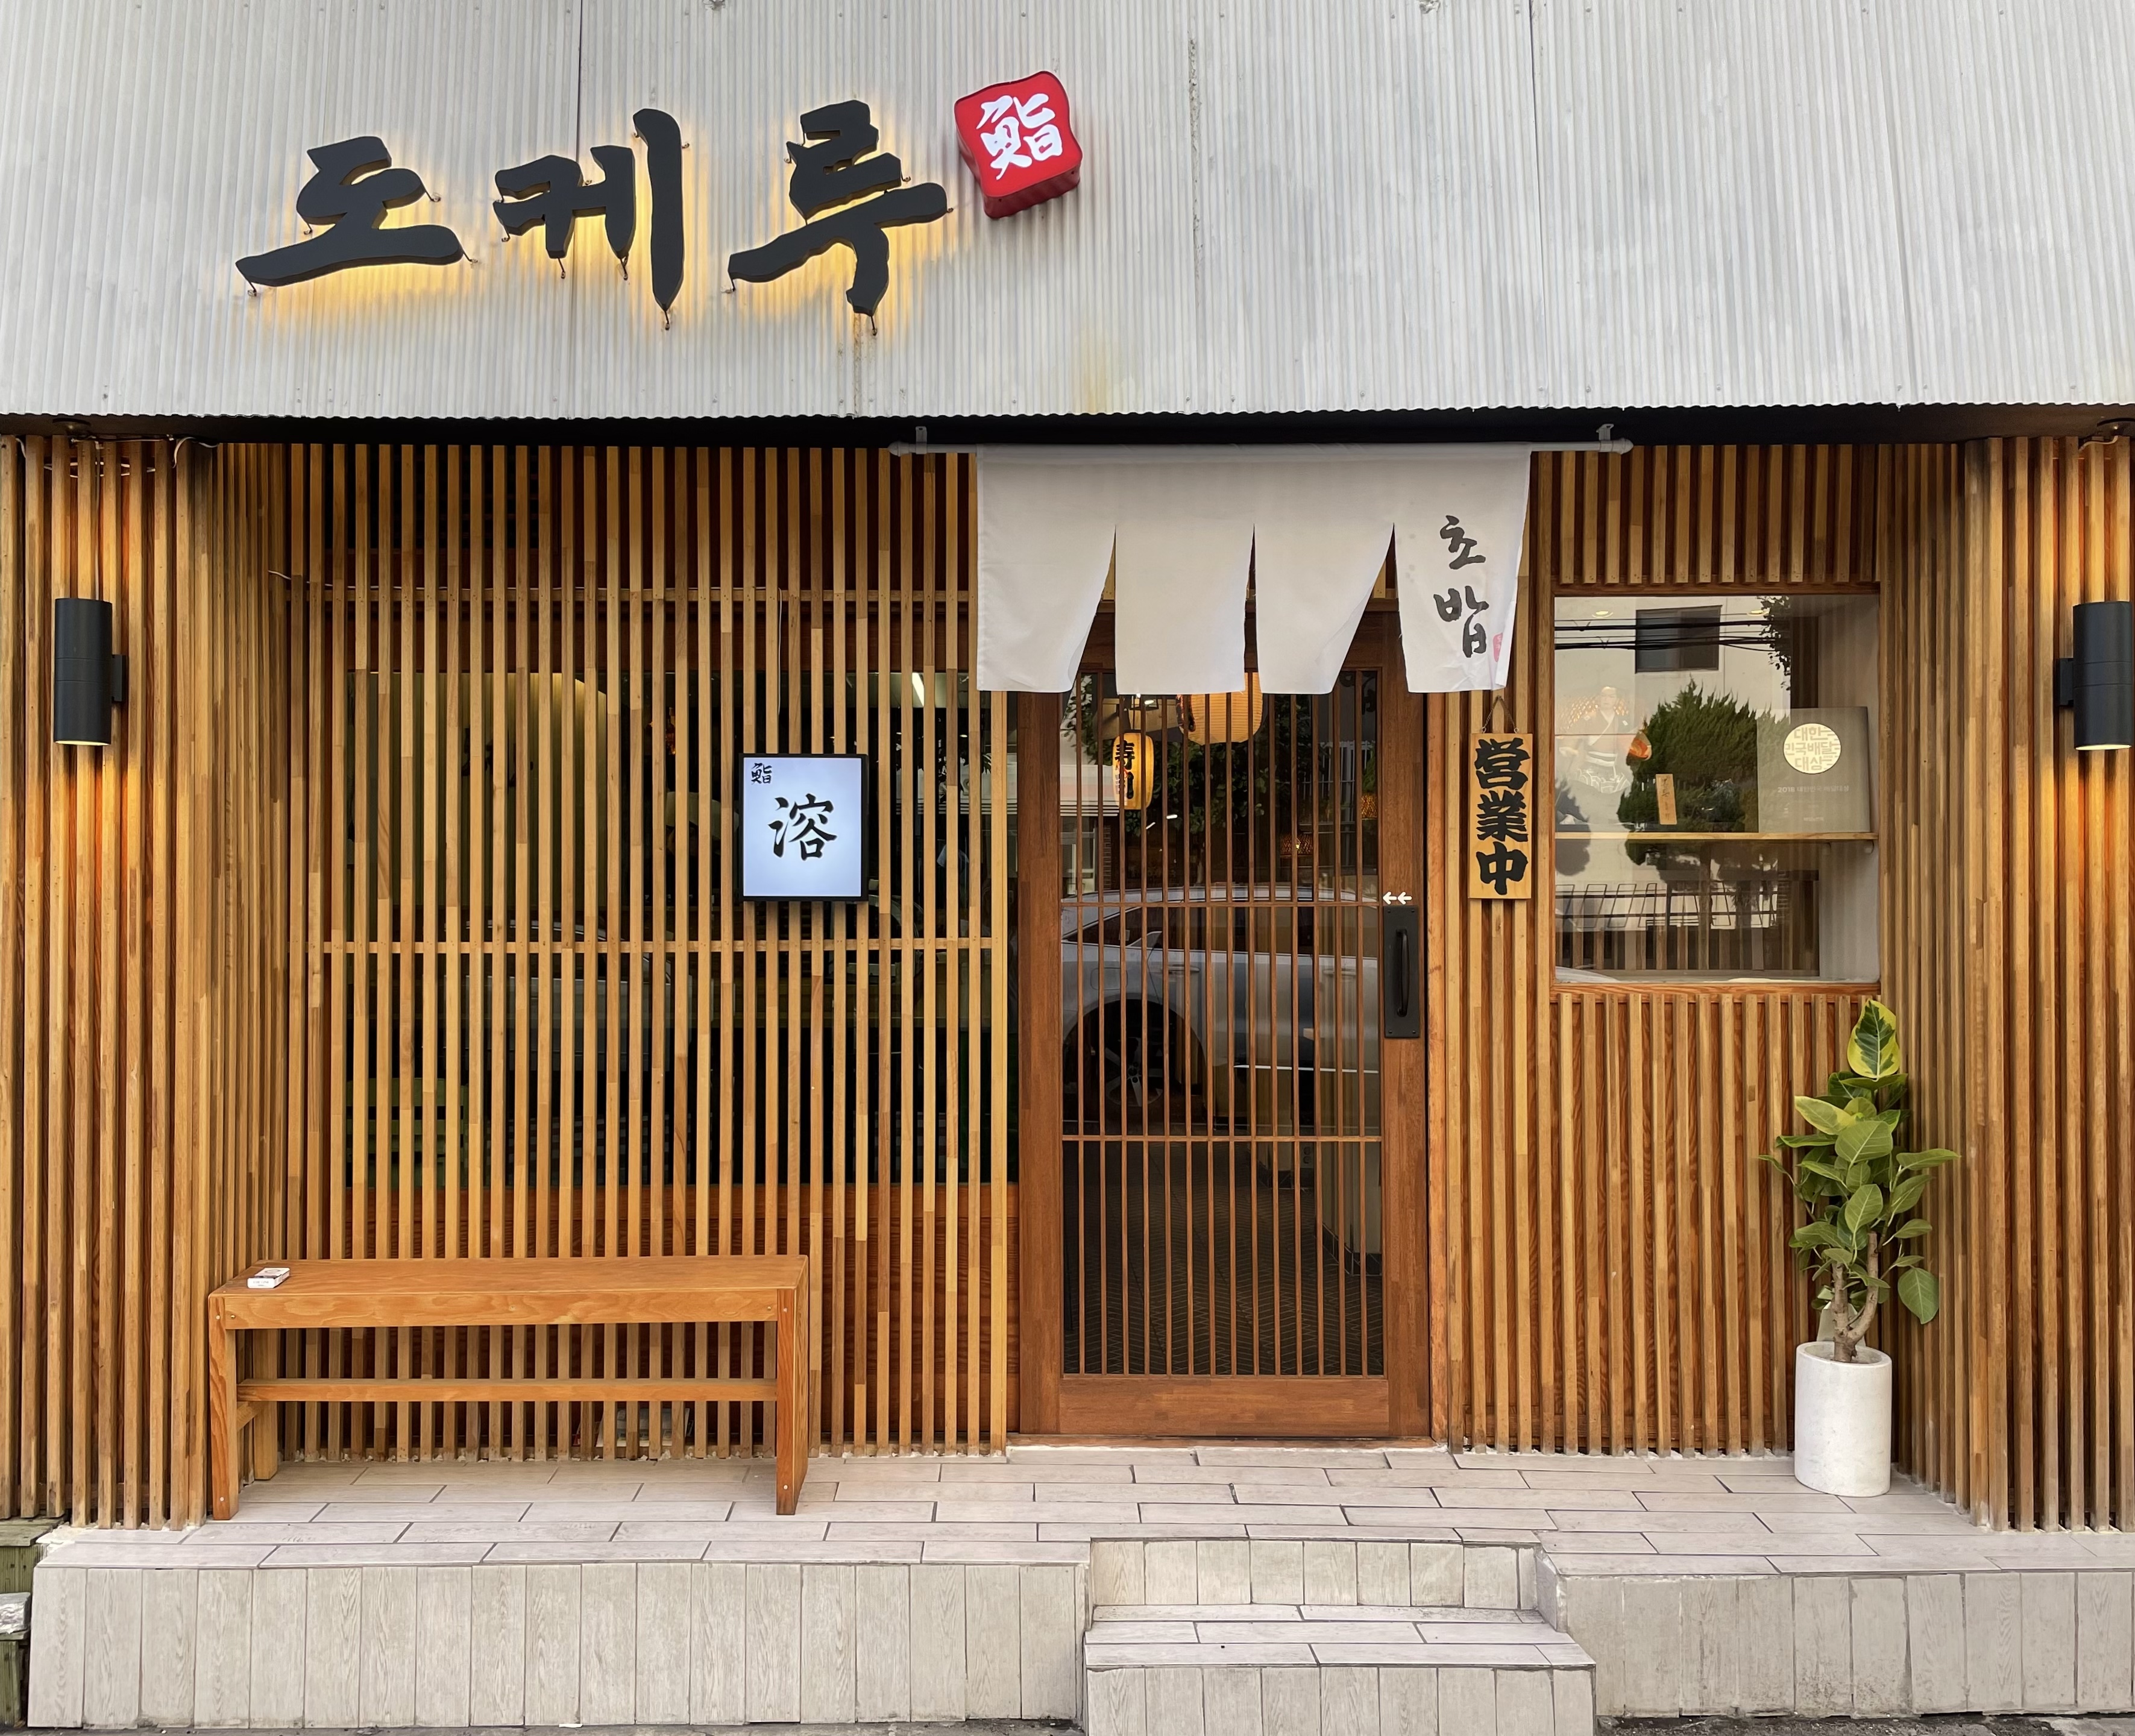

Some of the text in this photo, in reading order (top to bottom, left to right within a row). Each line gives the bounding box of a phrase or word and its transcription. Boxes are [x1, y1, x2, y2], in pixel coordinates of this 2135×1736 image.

[976, 93, 1055, 180] 鮨
[1433, 514, 1489, 658] 초밥
[1794, 726, 1829, 741] 대한
[1794, 755, 1823, 772] 대상
[751, 762, 772, 784] 鮨
[767, 793, 837, 861] 溶
[1474, 737, 1531, 896] 営業中
